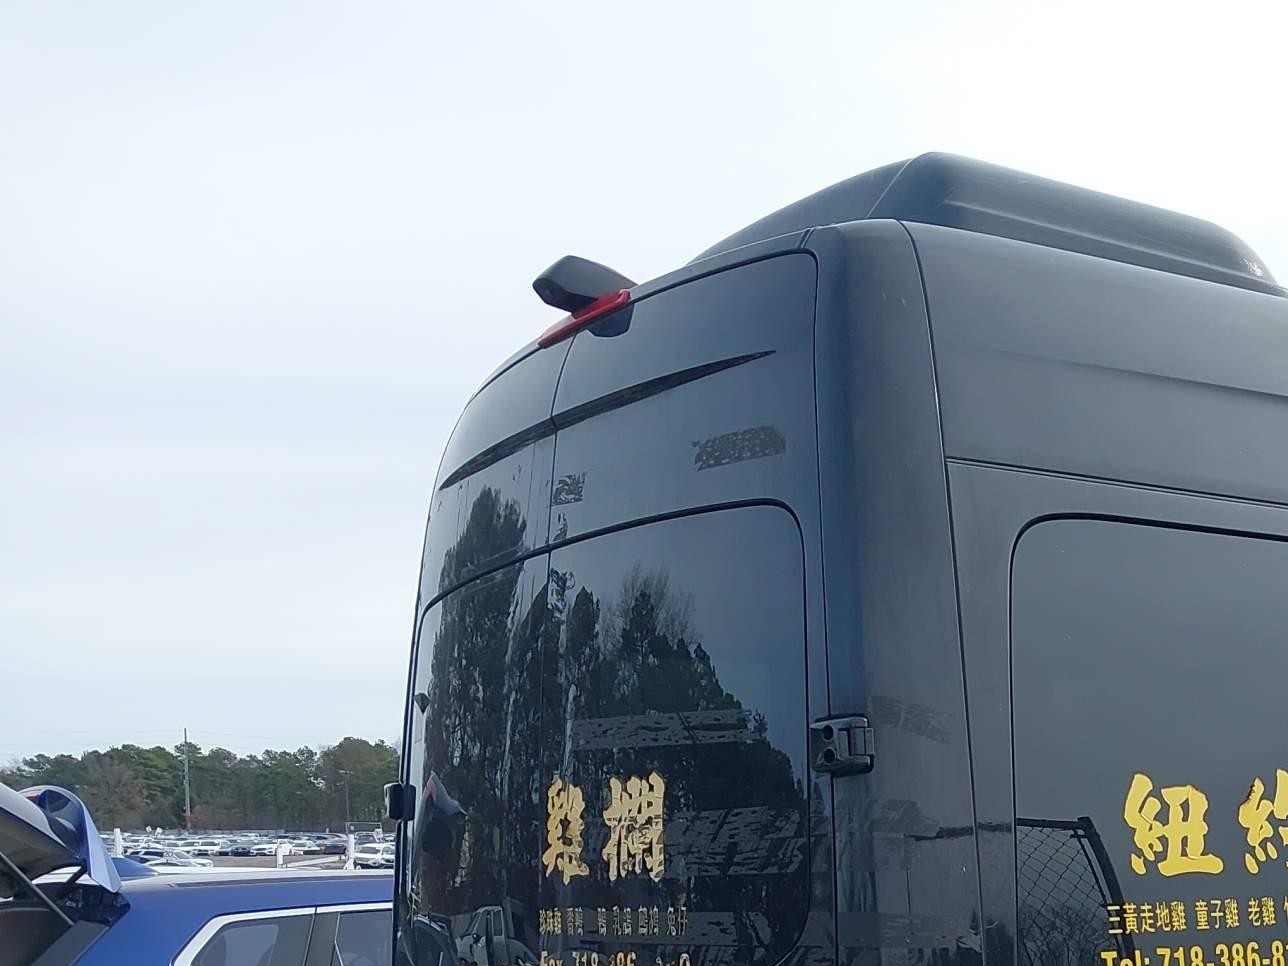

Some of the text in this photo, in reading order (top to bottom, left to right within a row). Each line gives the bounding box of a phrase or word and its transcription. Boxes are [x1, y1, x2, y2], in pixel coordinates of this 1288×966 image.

[1194, 899, 1240, 930] 童子雞
[1247, 897, 1276, 926] 老雞
